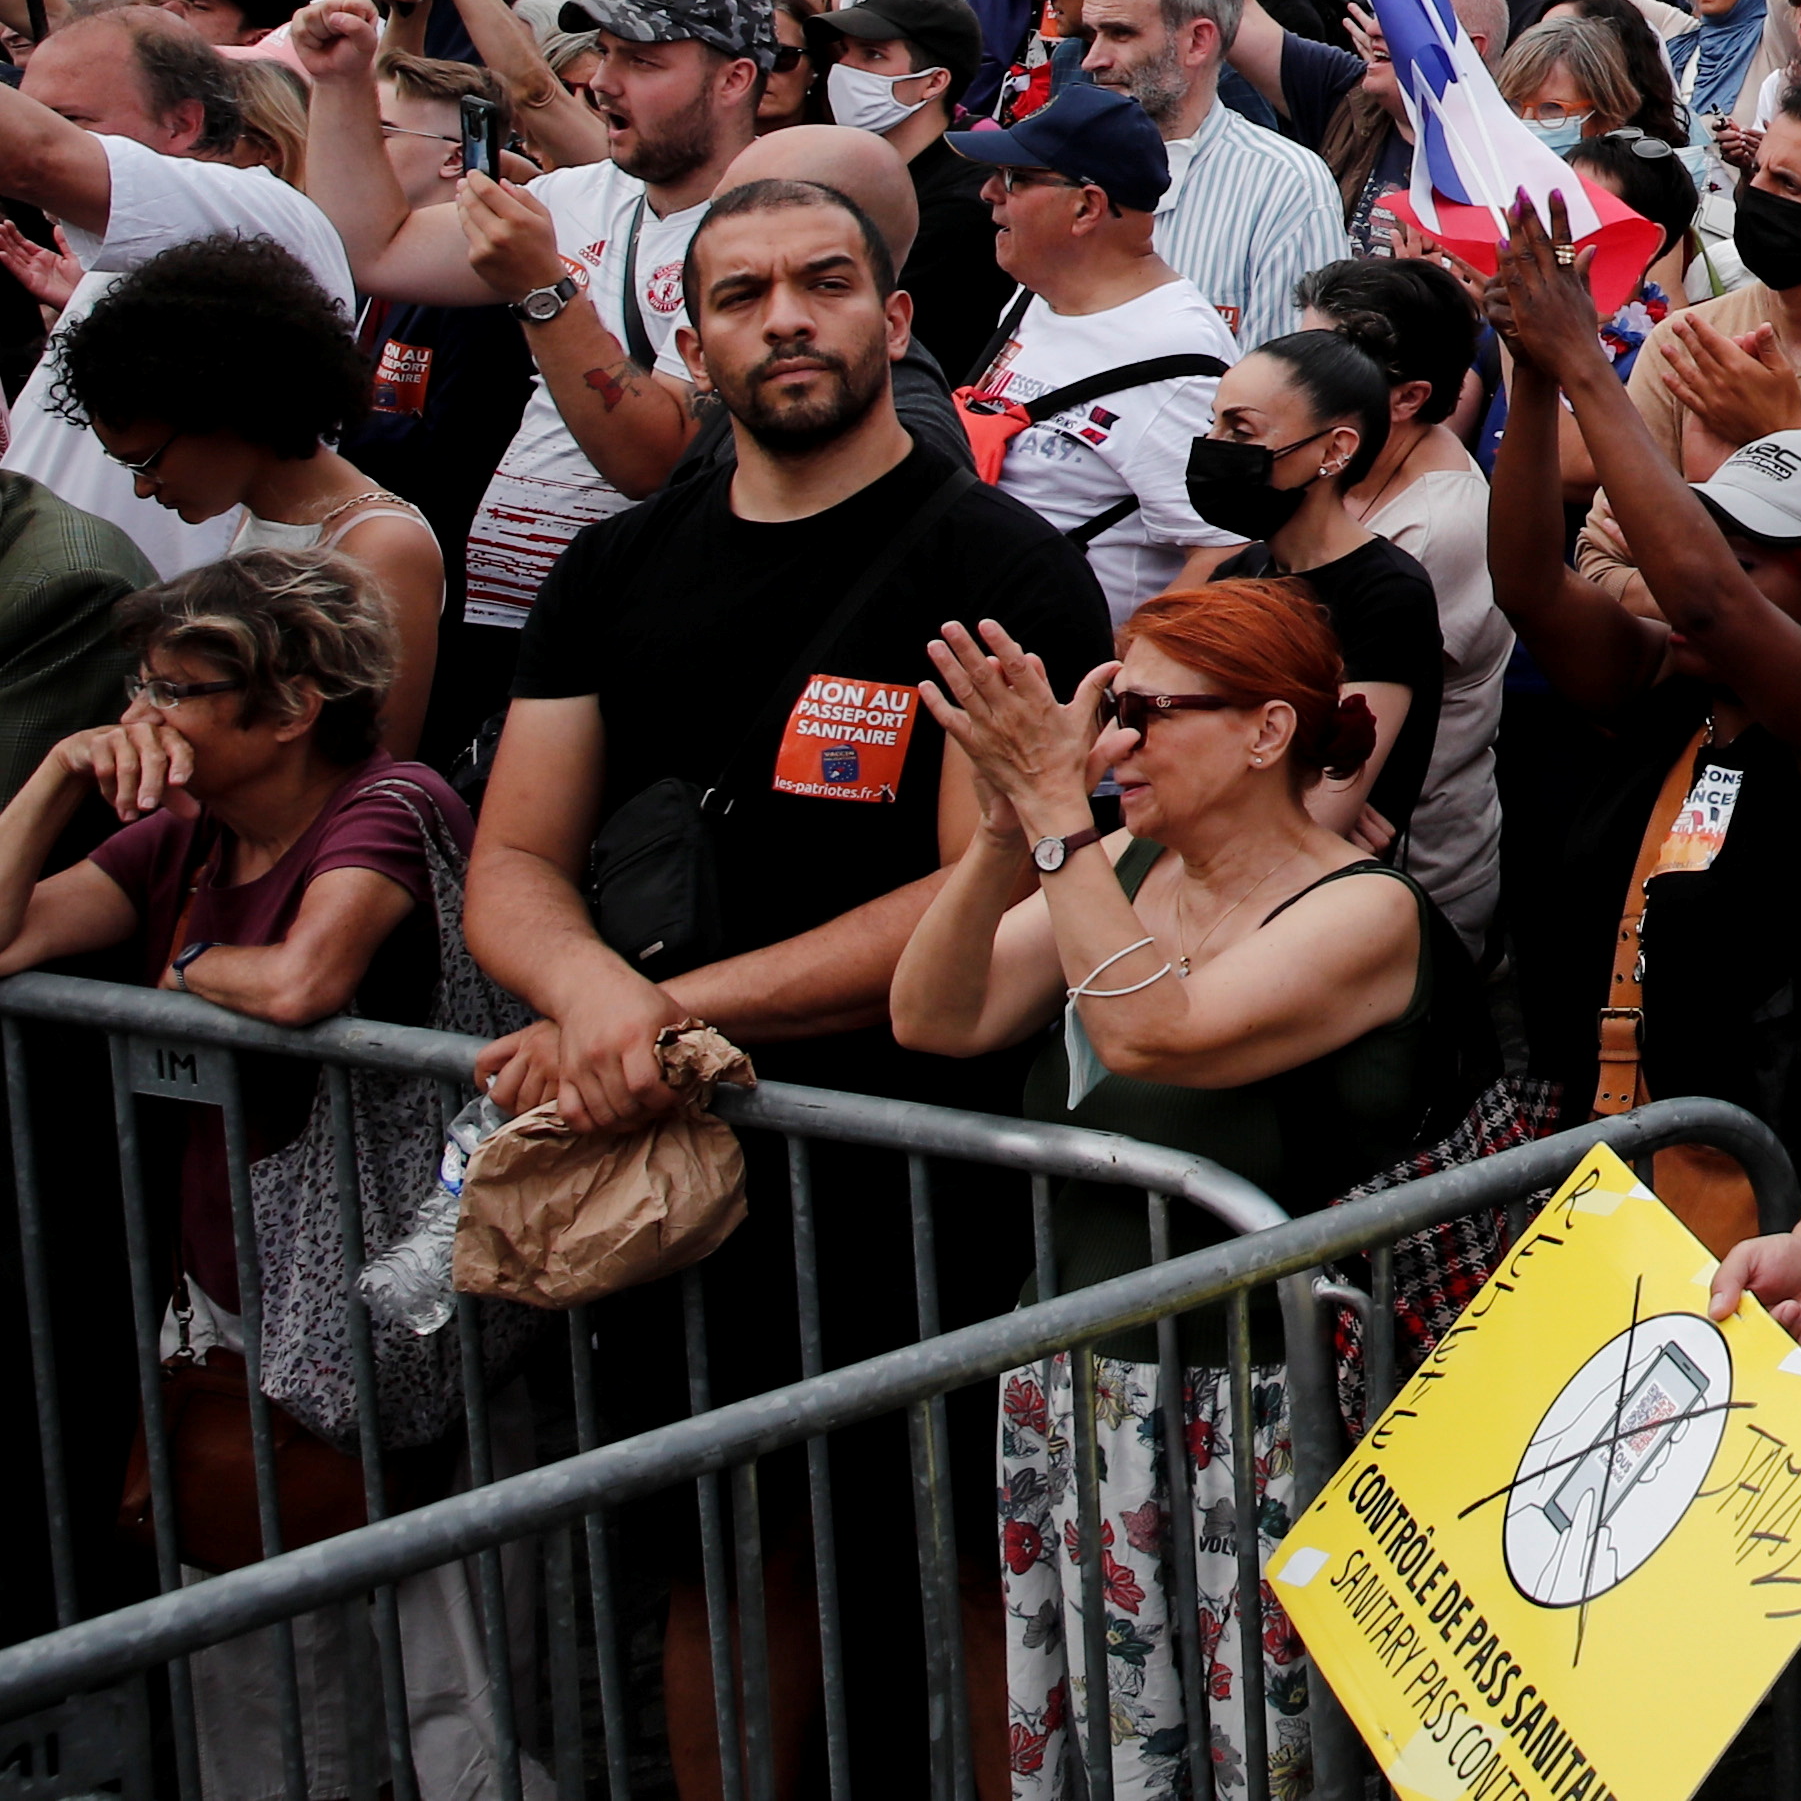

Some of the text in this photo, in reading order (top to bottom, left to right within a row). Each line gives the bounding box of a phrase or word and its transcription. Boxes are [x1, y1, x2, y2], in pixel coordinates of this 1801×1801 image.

[385, 341, 430, 362] ON AU
[802, 680, 910, 712] NON AU
[797, 700, 908, 729] PASSEPORT
[796, 719, 898, 747] SANITAIRE
[774, 771, 873, 800] les-patriotes.fr
[1348, 1463, 1449, 1607] CONTRÔLE
[1428, 1580, 1474, 1643] DE
[1453, 1616, 1522, 1708] PASS
[1330, 1549, 1427, 1678] SANITARY
[1403, 1659, 1468, 1743] PASS
